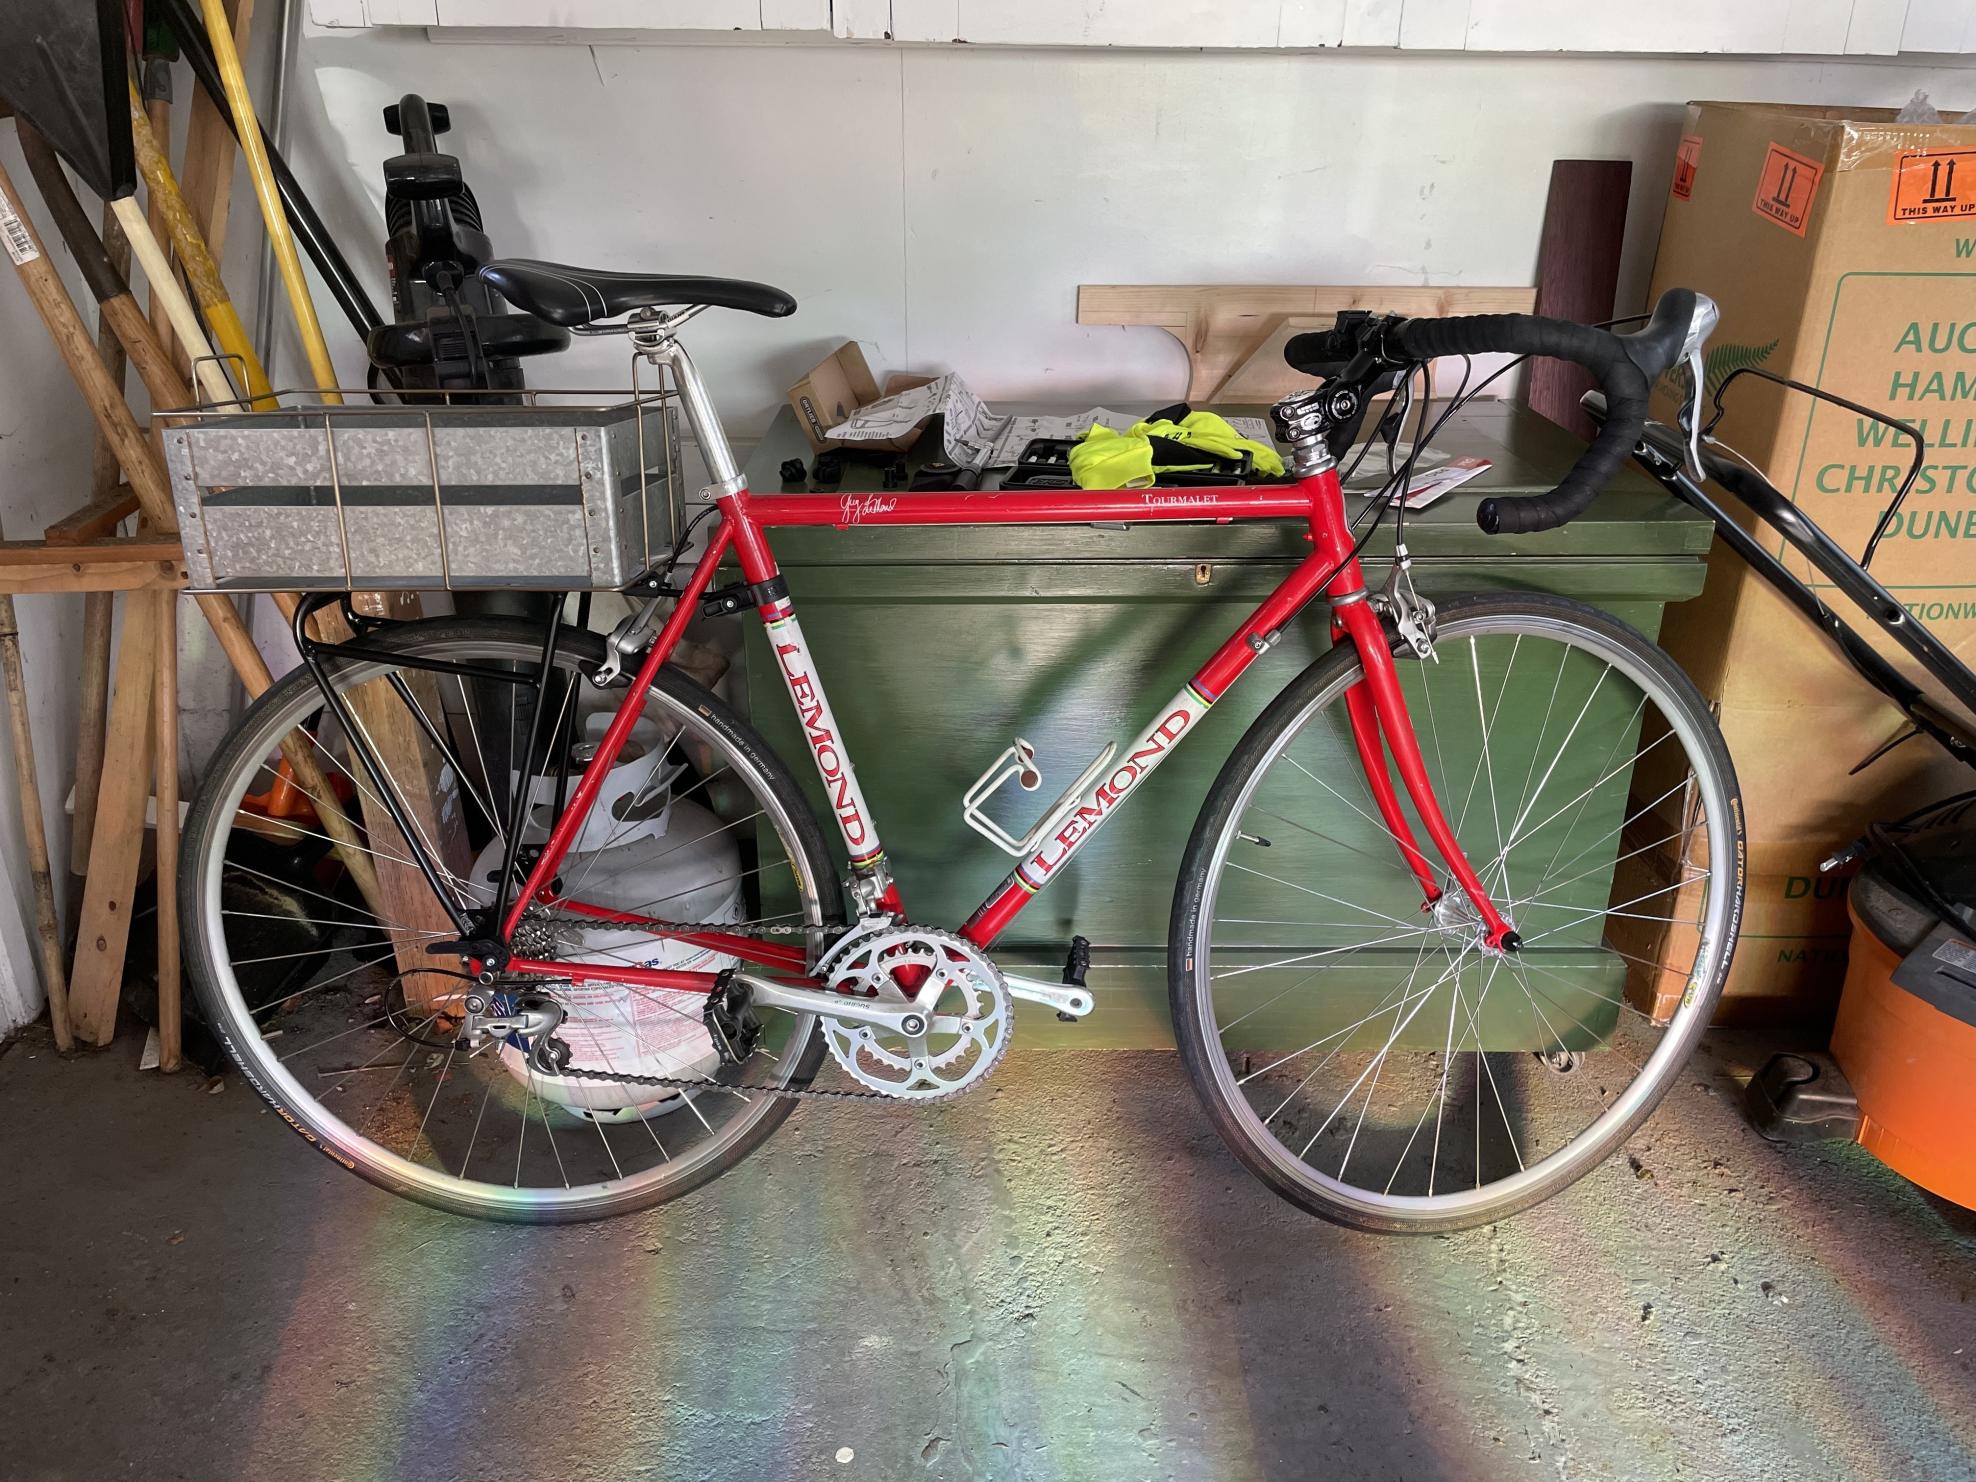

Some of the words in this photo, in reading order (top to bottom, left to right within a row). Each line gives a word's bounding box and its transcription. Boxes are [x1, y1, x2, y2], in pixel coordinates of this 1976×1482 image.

[1760, 199, 1773, 211] THIS
[1774, 207, 1788, 219] WAY
[1790, 215, 1799, 223] UP
[1901, 207, 1928, 216] THIS
[1932, 205, 1957, 214] WAY
[1960, 203, 1976, 213] UP
[1893, 321, 1976, 353] AUC
[1888, 371, 1976, 401] HAM
[1856, 418, 1976, 448] WELLI
[1141, 493, 1219, 504] TOURMALET
[710, 713, 745, 746] handmade
[744, 743, 752, 753] in
[749, 751, 776, 781] germany
[775, 642, 866, 847] LEMOND
[1030, 708, 1191, 877] LEMOND
[1784, 876, 1849, 898] DU
[1186, 913, 1196, 957] handmade
[1194, 867, 1207, 903] germany
[323, 1146, 355, 1169] Continental
